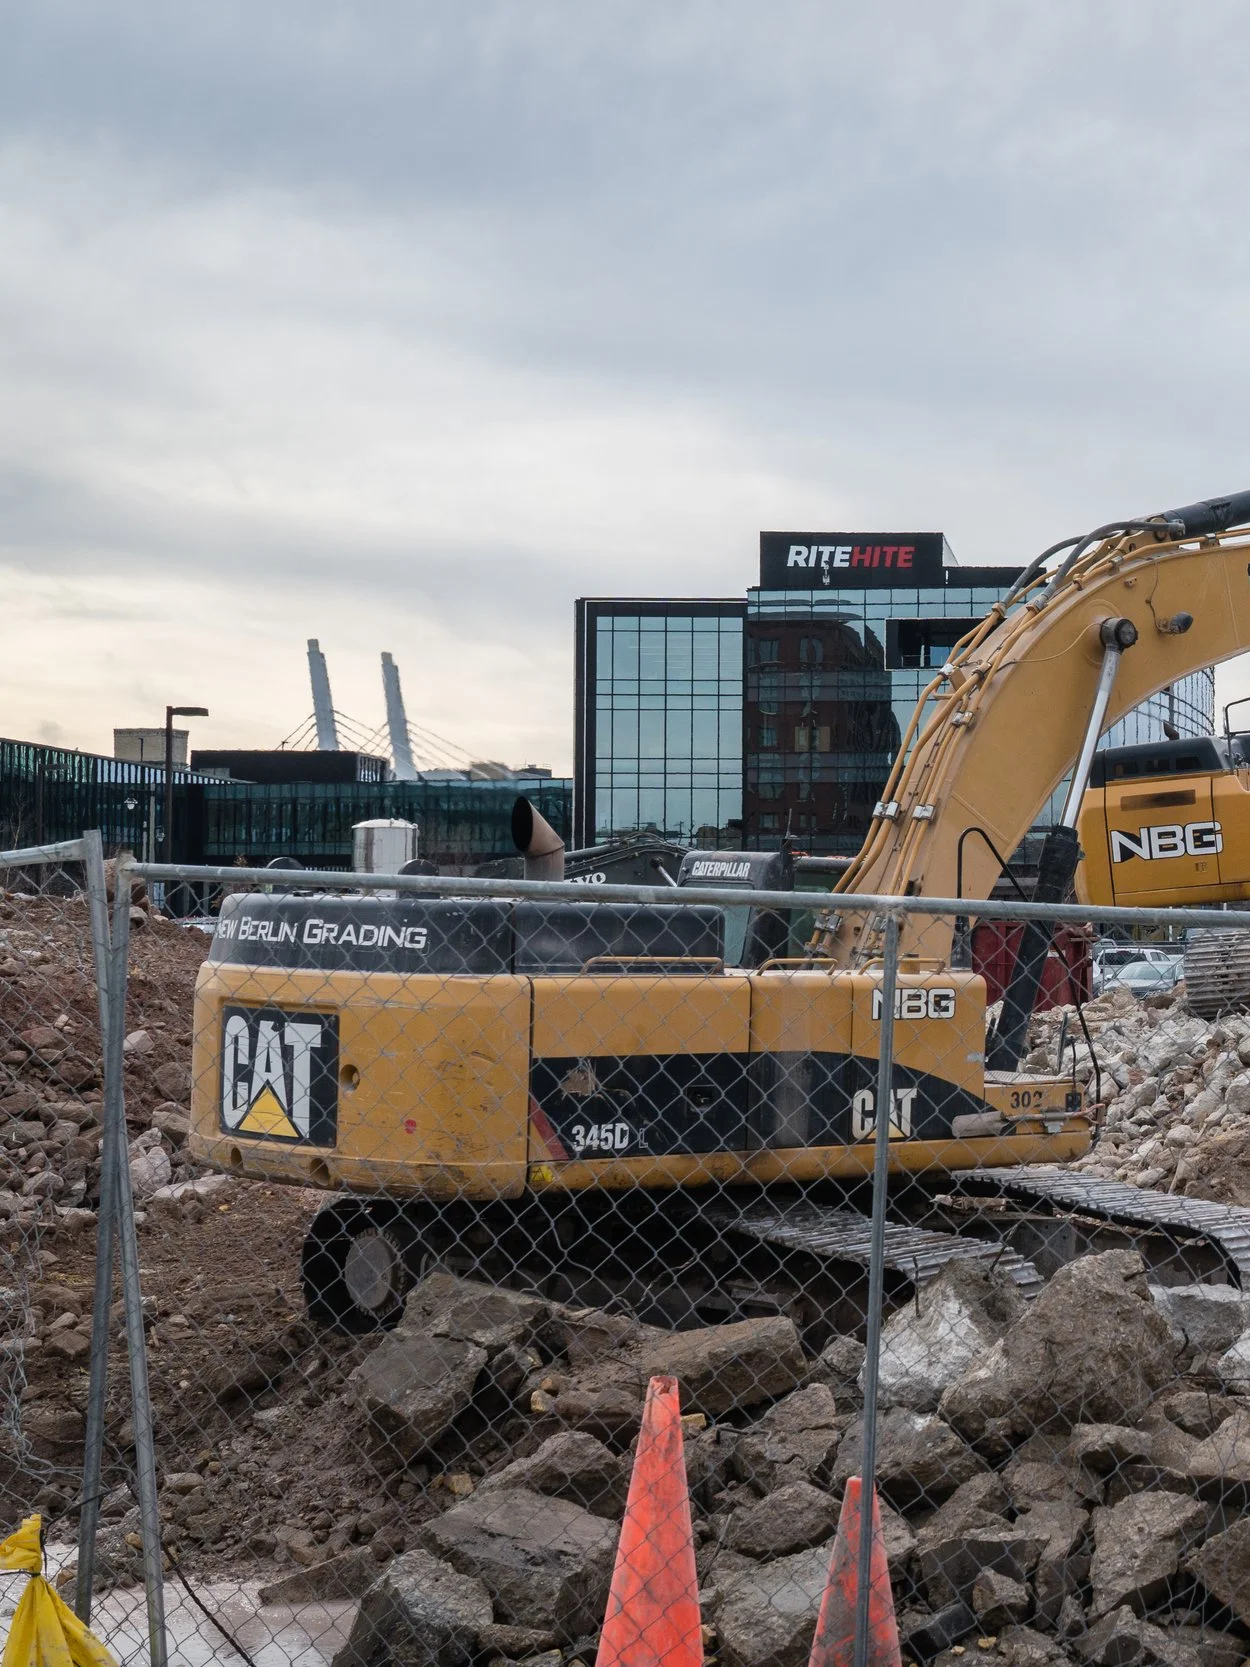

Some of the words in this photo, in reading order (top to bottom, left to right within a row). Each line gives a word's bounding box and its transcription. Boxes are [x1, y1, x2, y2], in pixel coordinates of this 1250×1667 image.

[1110, 821, 1224, 864] NBG
[691, 861, 751, 878] CATERPILLAR
[238, 916, 298, 943] BERLIN
[303, 918, 428, 949] GRADING
[872, 988, 956, 1020] NBG
[223, 1015, 322, 1139] CAT
[1010, 1090, 1043, 1109] 302
[571, 1122, 630, 1152] 345D
